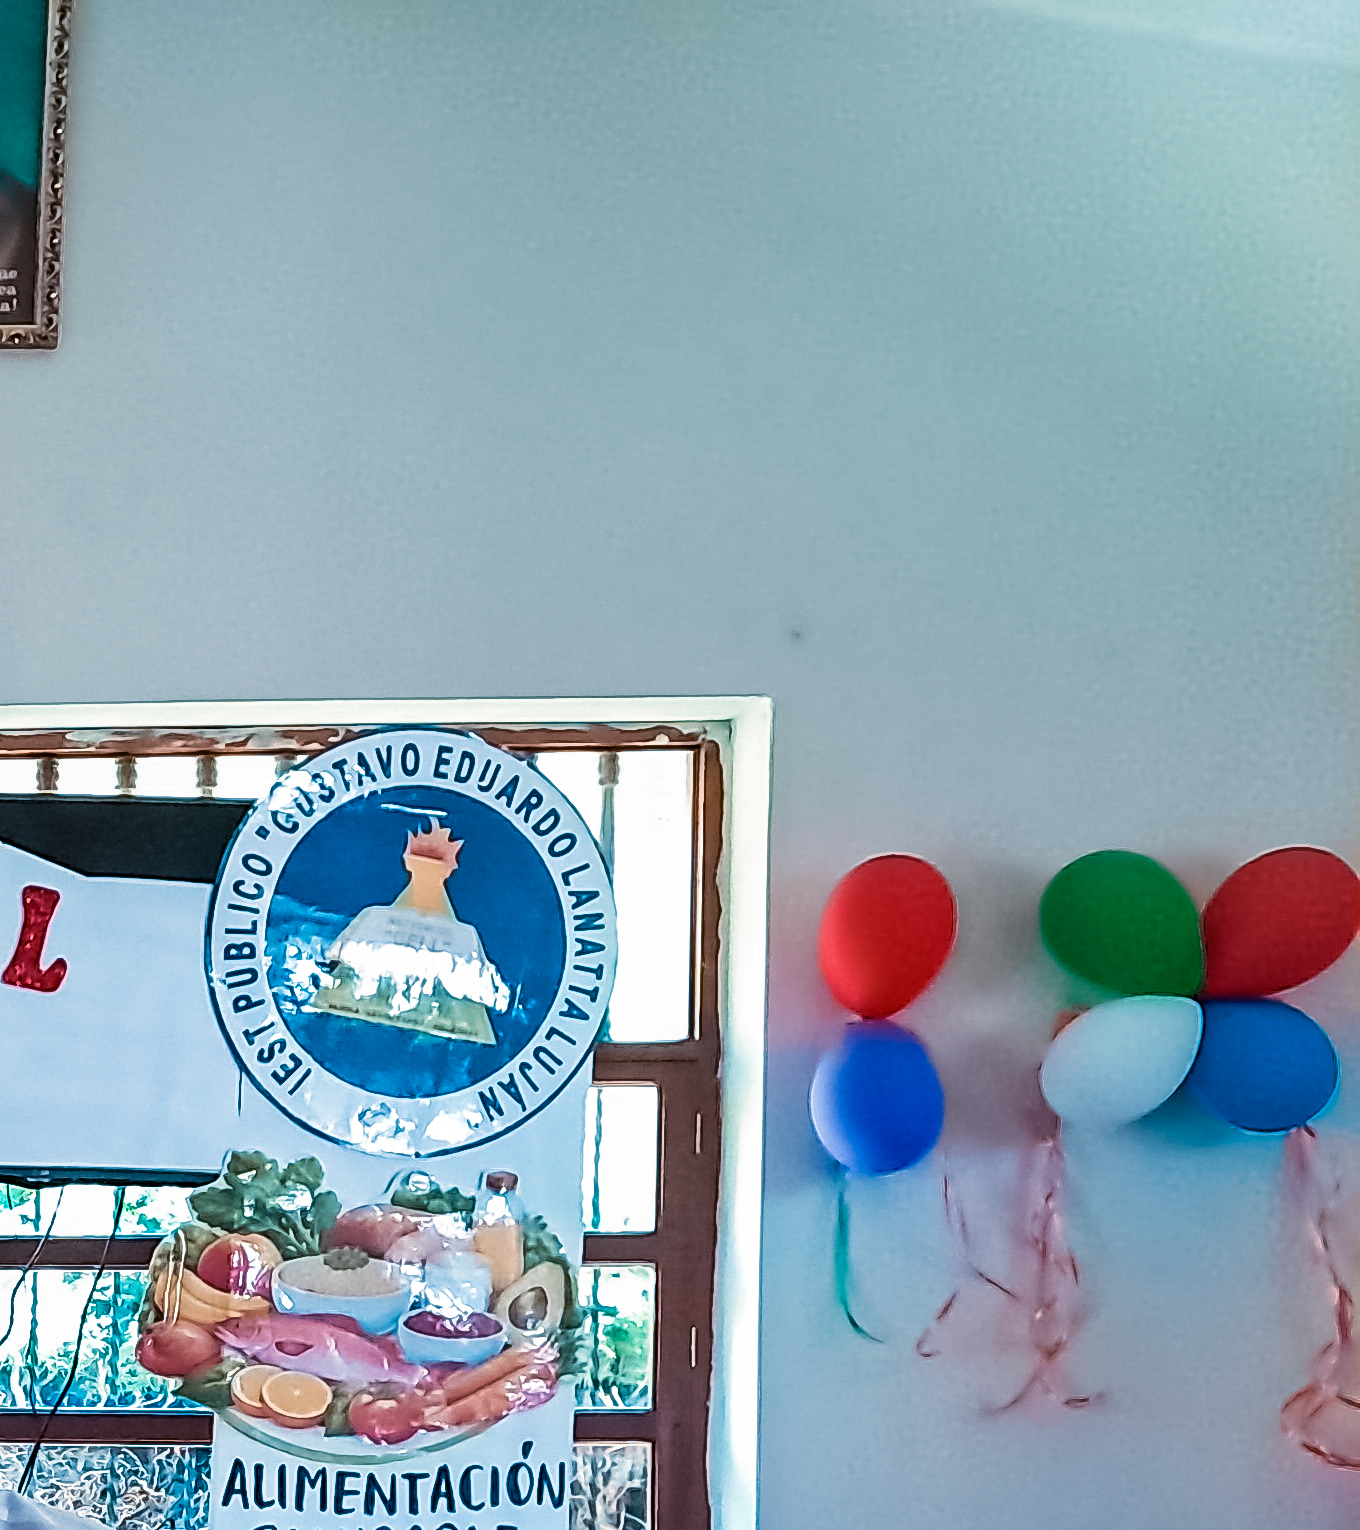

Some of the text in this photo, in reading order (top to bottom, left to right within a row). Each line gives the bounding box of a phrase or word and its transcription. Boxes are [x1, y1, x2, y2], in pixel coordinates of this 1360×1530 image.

[242, 1022, 312, 1095] IEST
[433, 745, 577, 858] EDUARDO
[559, 863, 607, 1022] LANATTA
[221, 1441, 566, 1516] ALIMENTACIÓN
